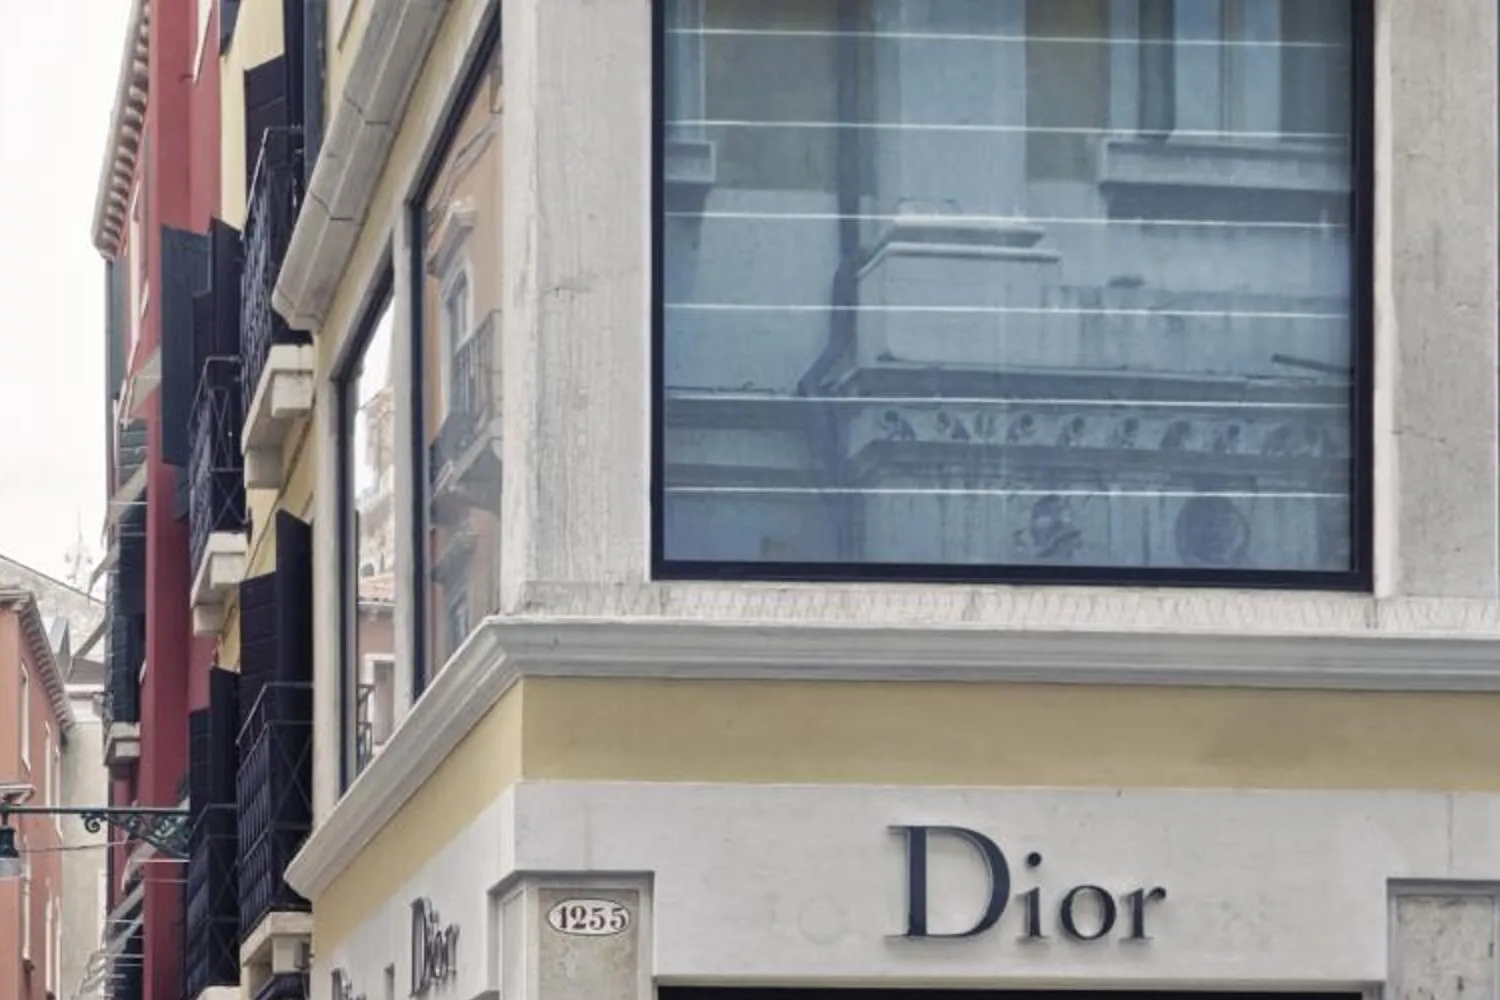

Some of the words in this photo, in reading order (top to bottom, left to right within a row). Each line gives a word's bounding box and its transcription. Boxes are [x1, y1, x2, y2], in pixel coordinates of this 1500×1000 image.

[559, 905, 628, 930] 1255
[888, 825, 1167, 942] Dior
[410, 896, 459, 998] Dior
